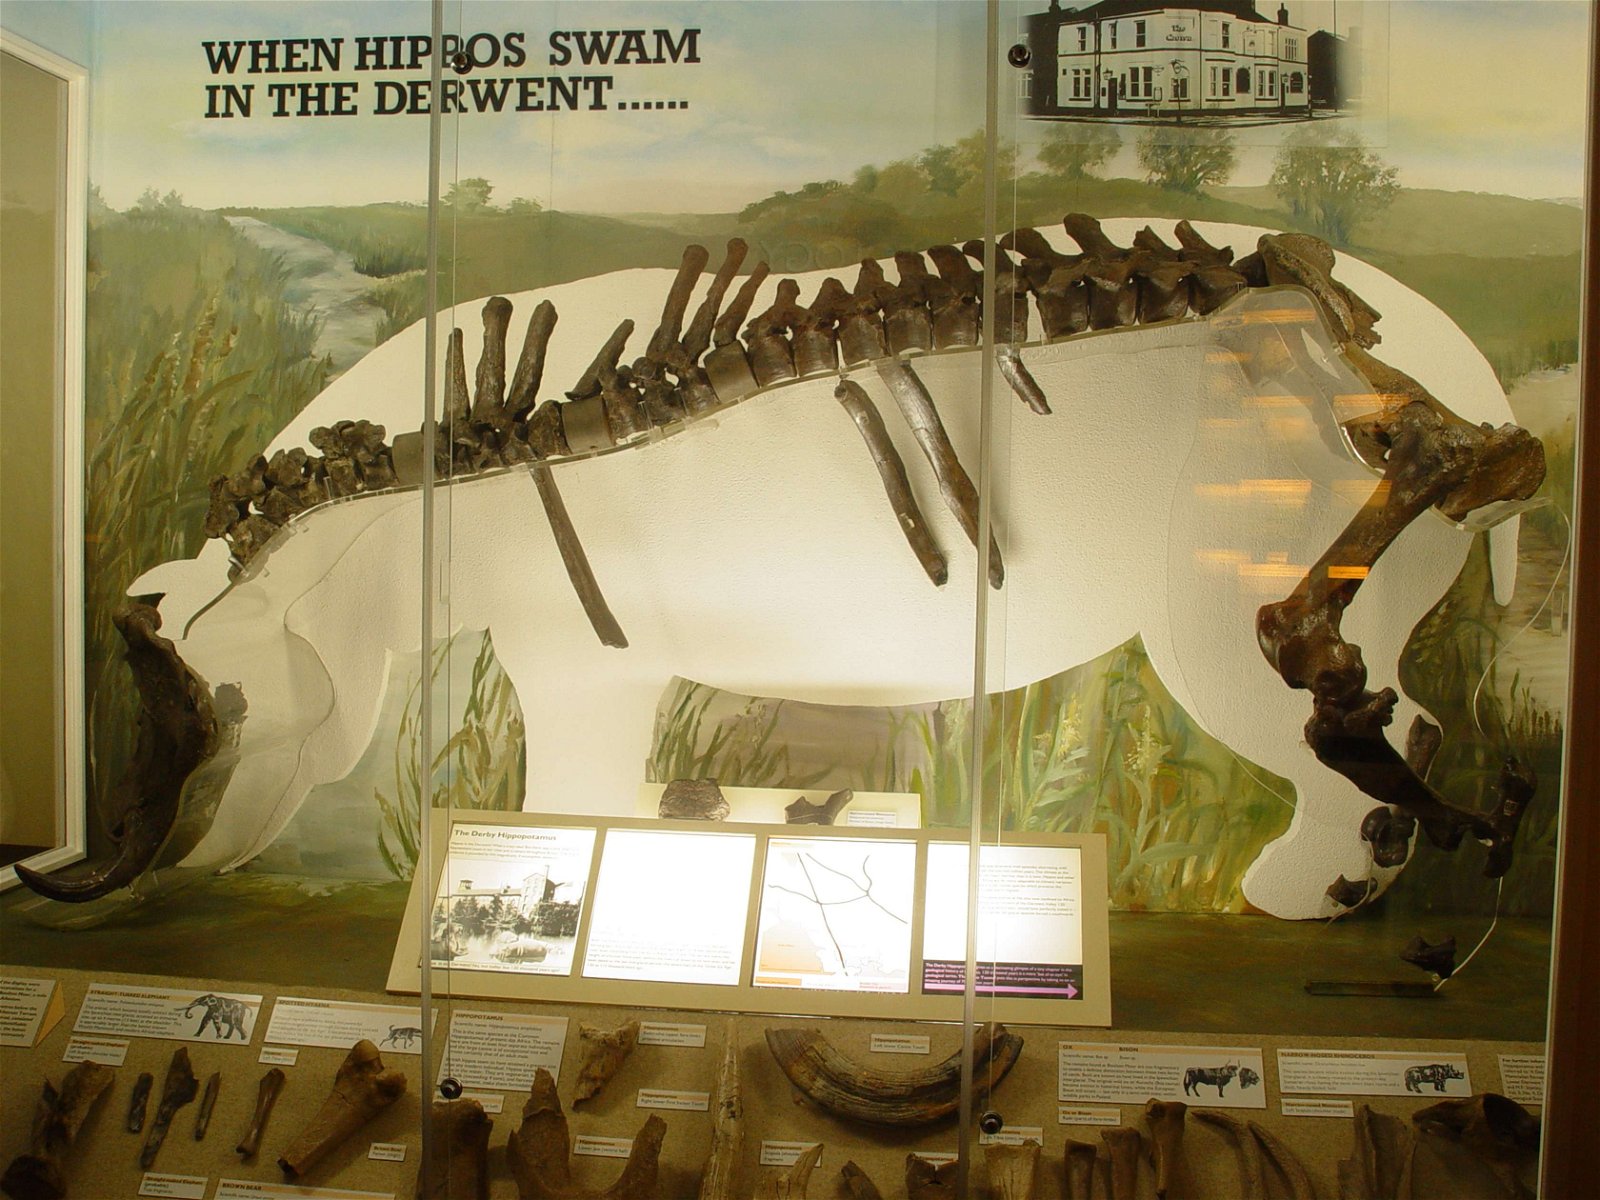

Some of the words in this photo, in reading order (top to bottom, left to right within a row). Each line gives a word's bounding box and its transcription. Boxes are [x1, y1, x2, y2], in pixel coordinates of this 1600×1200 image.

[201, 37, 345, 75] WHEN
[354, 32, 527, 72] HIPPOS
[549, 28, 702, 66] SWAM
[204, 83, 256, 118] IN
[267, 81, 360, 117] THE
[454, 829, 470, 837] The
[470, 830, 496, 840] Derby
[497, 831, 558, 842] Hippopotamus
[455, 1013, 504, 1021] HIPPOPOTAMUS
[222, 1182, 246, 1190] BROWN
